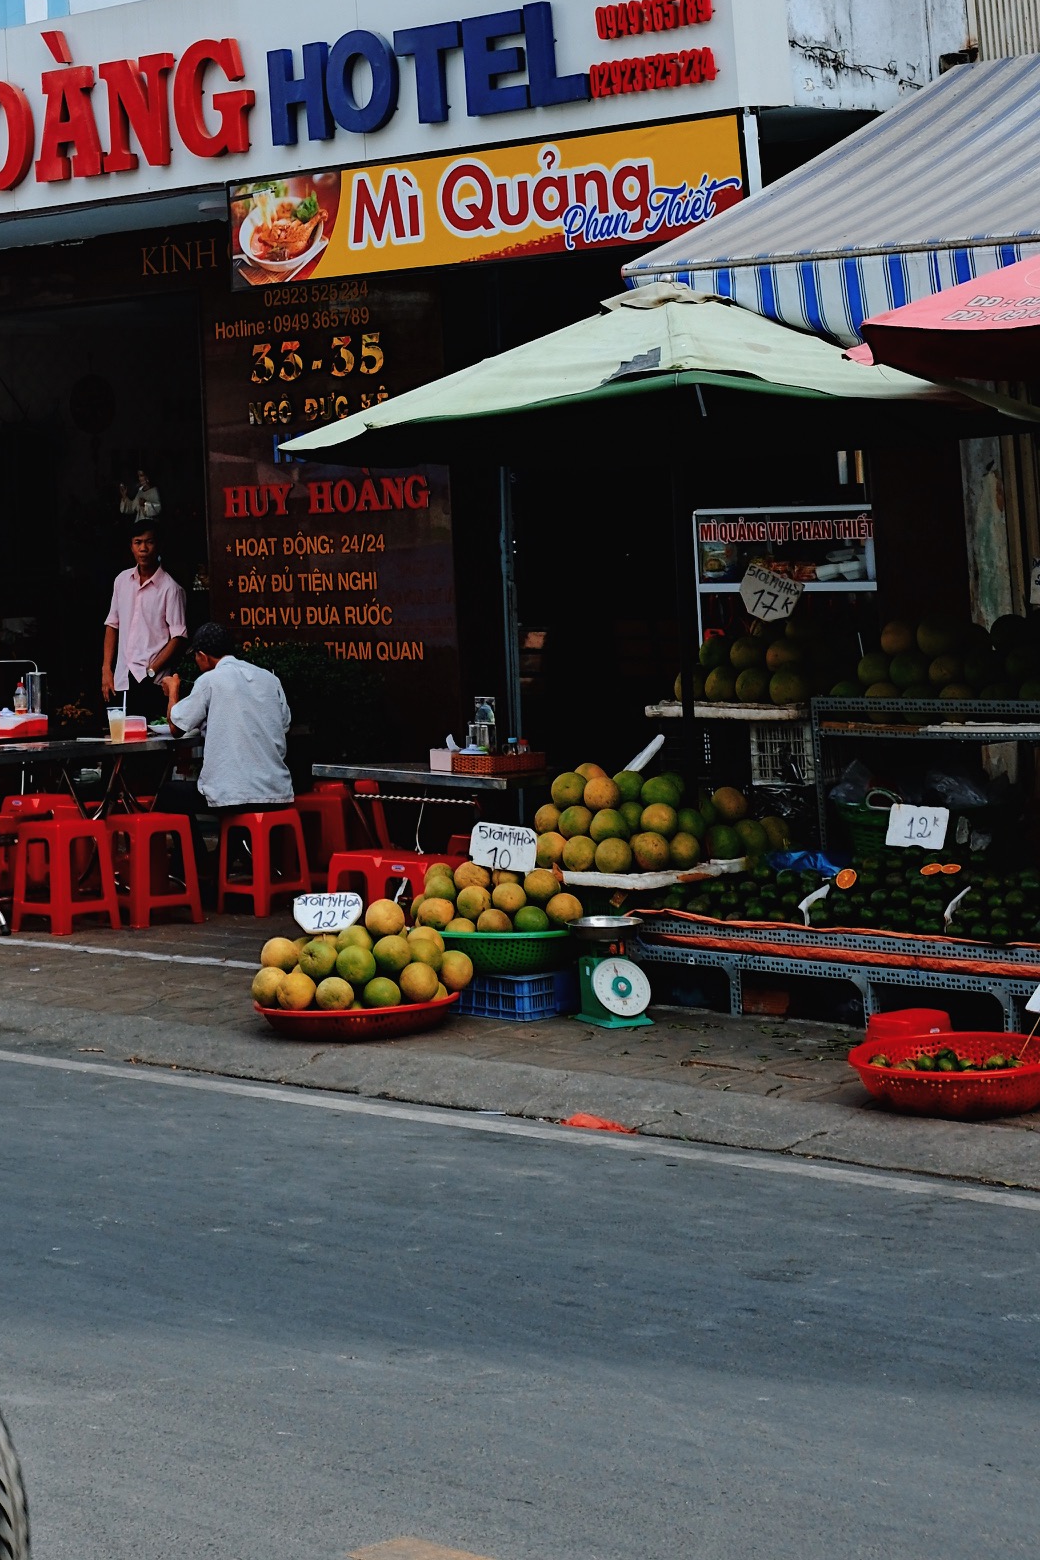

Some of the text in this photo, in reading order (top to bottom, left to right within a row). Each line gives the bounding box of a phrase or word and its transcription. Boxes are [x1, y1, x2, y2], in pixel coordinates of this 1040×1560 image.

[266, 1, 591, 146] HOTEL
[351, 148, 653, 246] Mì Quảng
[562, 174, 742, 251] Phan Thiết
[141, 236, 218, 276] KÍNH
[264, 285, 308, 307] 02923
[273, 314, 309, 333] 0949
[312, 310, 338, 330] 365
[342, 306, 370, 326] 789
[248, 392, 293, 425] NGÔ
[223, 468, 431, 518] HUY HOÀNG
[699, 513, 874, 545] MÌ QUẢNG VỊT PHAN THIẾT
[235, 531, 386, 561] HOẠT ĐỘNG: 24/24
[238, 566, 378, 596] ĐẦY ĐỦ TIỆN NGHI
[240, 597, 394, 630] DỊCH VỤ ĐƯA RƯỚC
[324, 641, 372, 661] THAM
[375, 641, 424, 662] QUAN
[487, 846, 512, 870] 10
